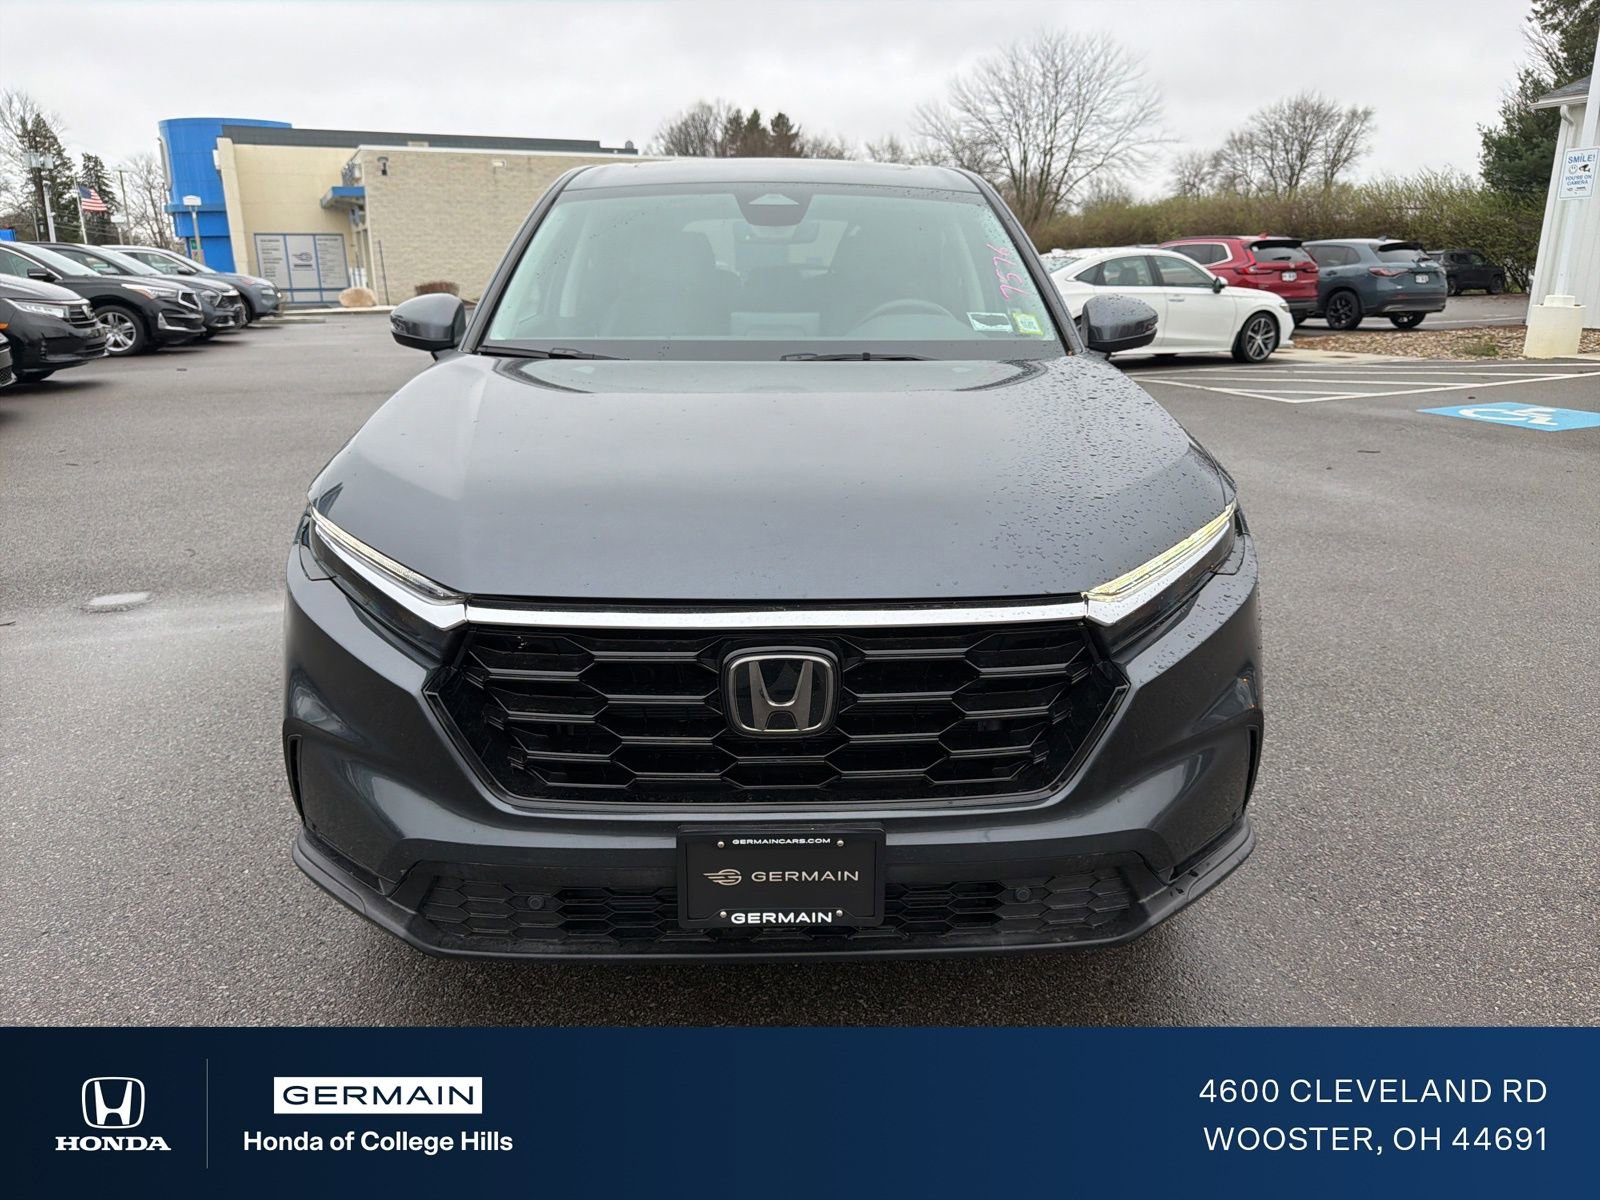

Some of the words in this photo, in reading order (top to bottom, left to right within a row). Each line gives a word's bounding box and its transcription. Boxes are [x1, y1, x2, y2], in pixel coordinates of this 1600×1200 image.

[1568, 154, 1595, 164] SMILE!
[751, 871, 859, 882] GERMAIN
[730, 911, 832, 924] GERMAIN
